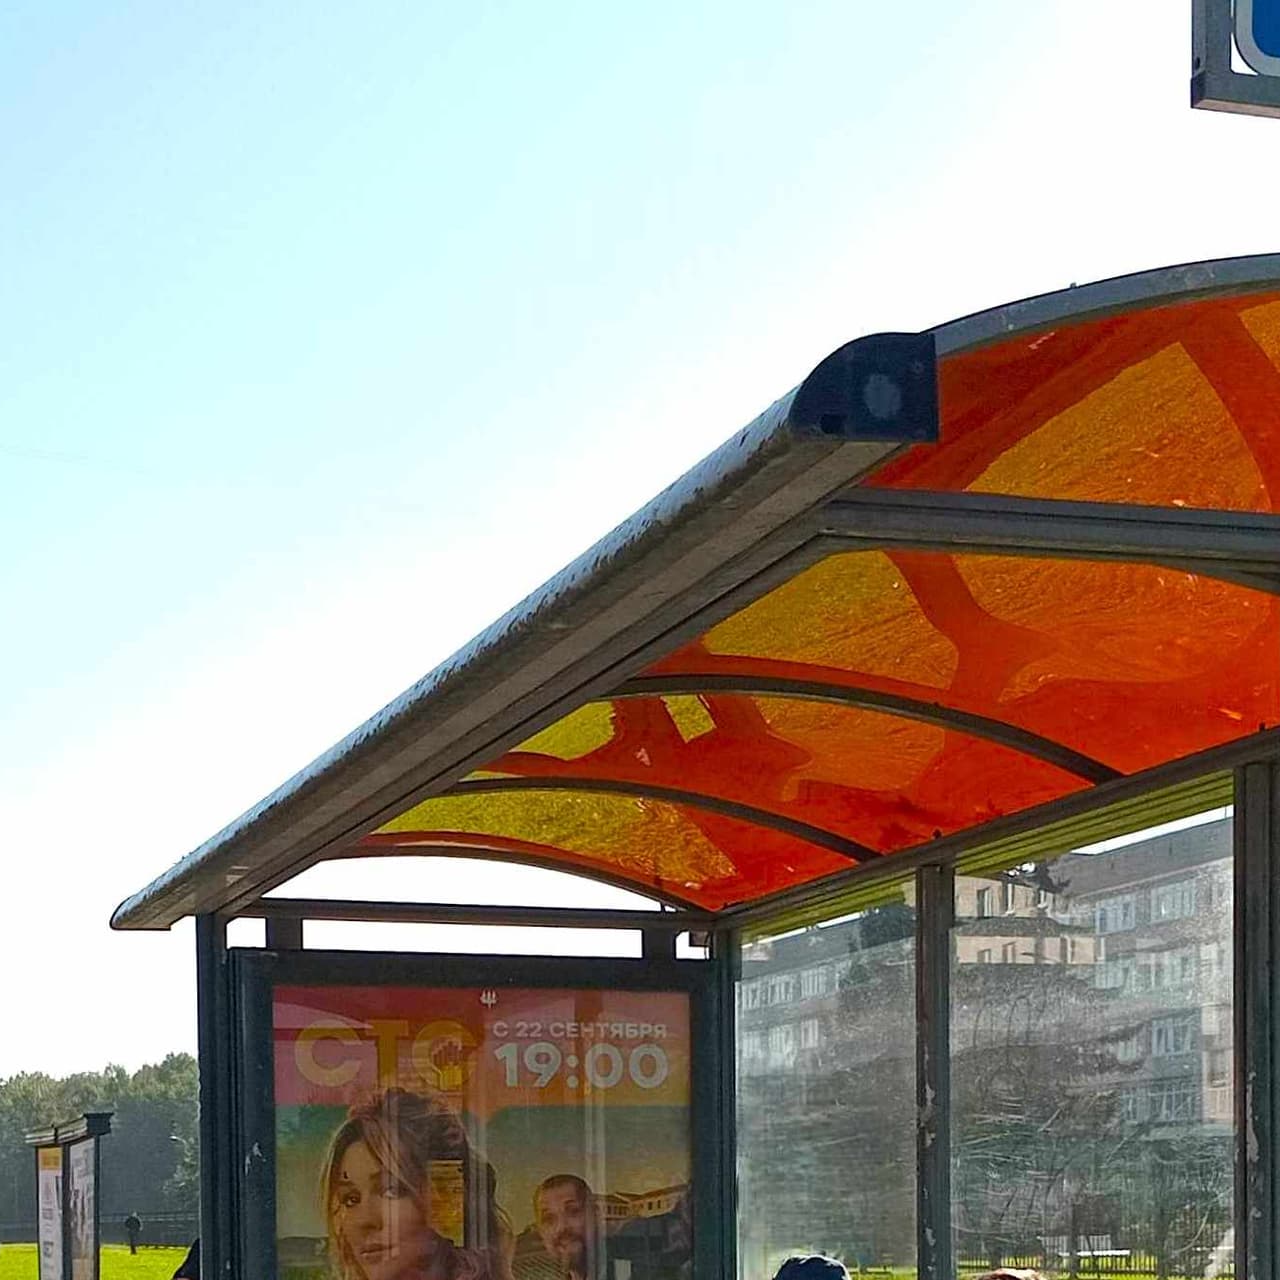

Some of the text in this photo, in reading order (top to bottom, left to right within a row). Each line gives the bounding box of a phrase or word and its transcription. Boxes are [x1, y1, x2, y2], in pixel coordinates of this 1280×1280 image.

[492, 1021, 669, 1038] С 22 СЕНТЯБРЯ
[493, 1042, 669, 1089] 19:00
